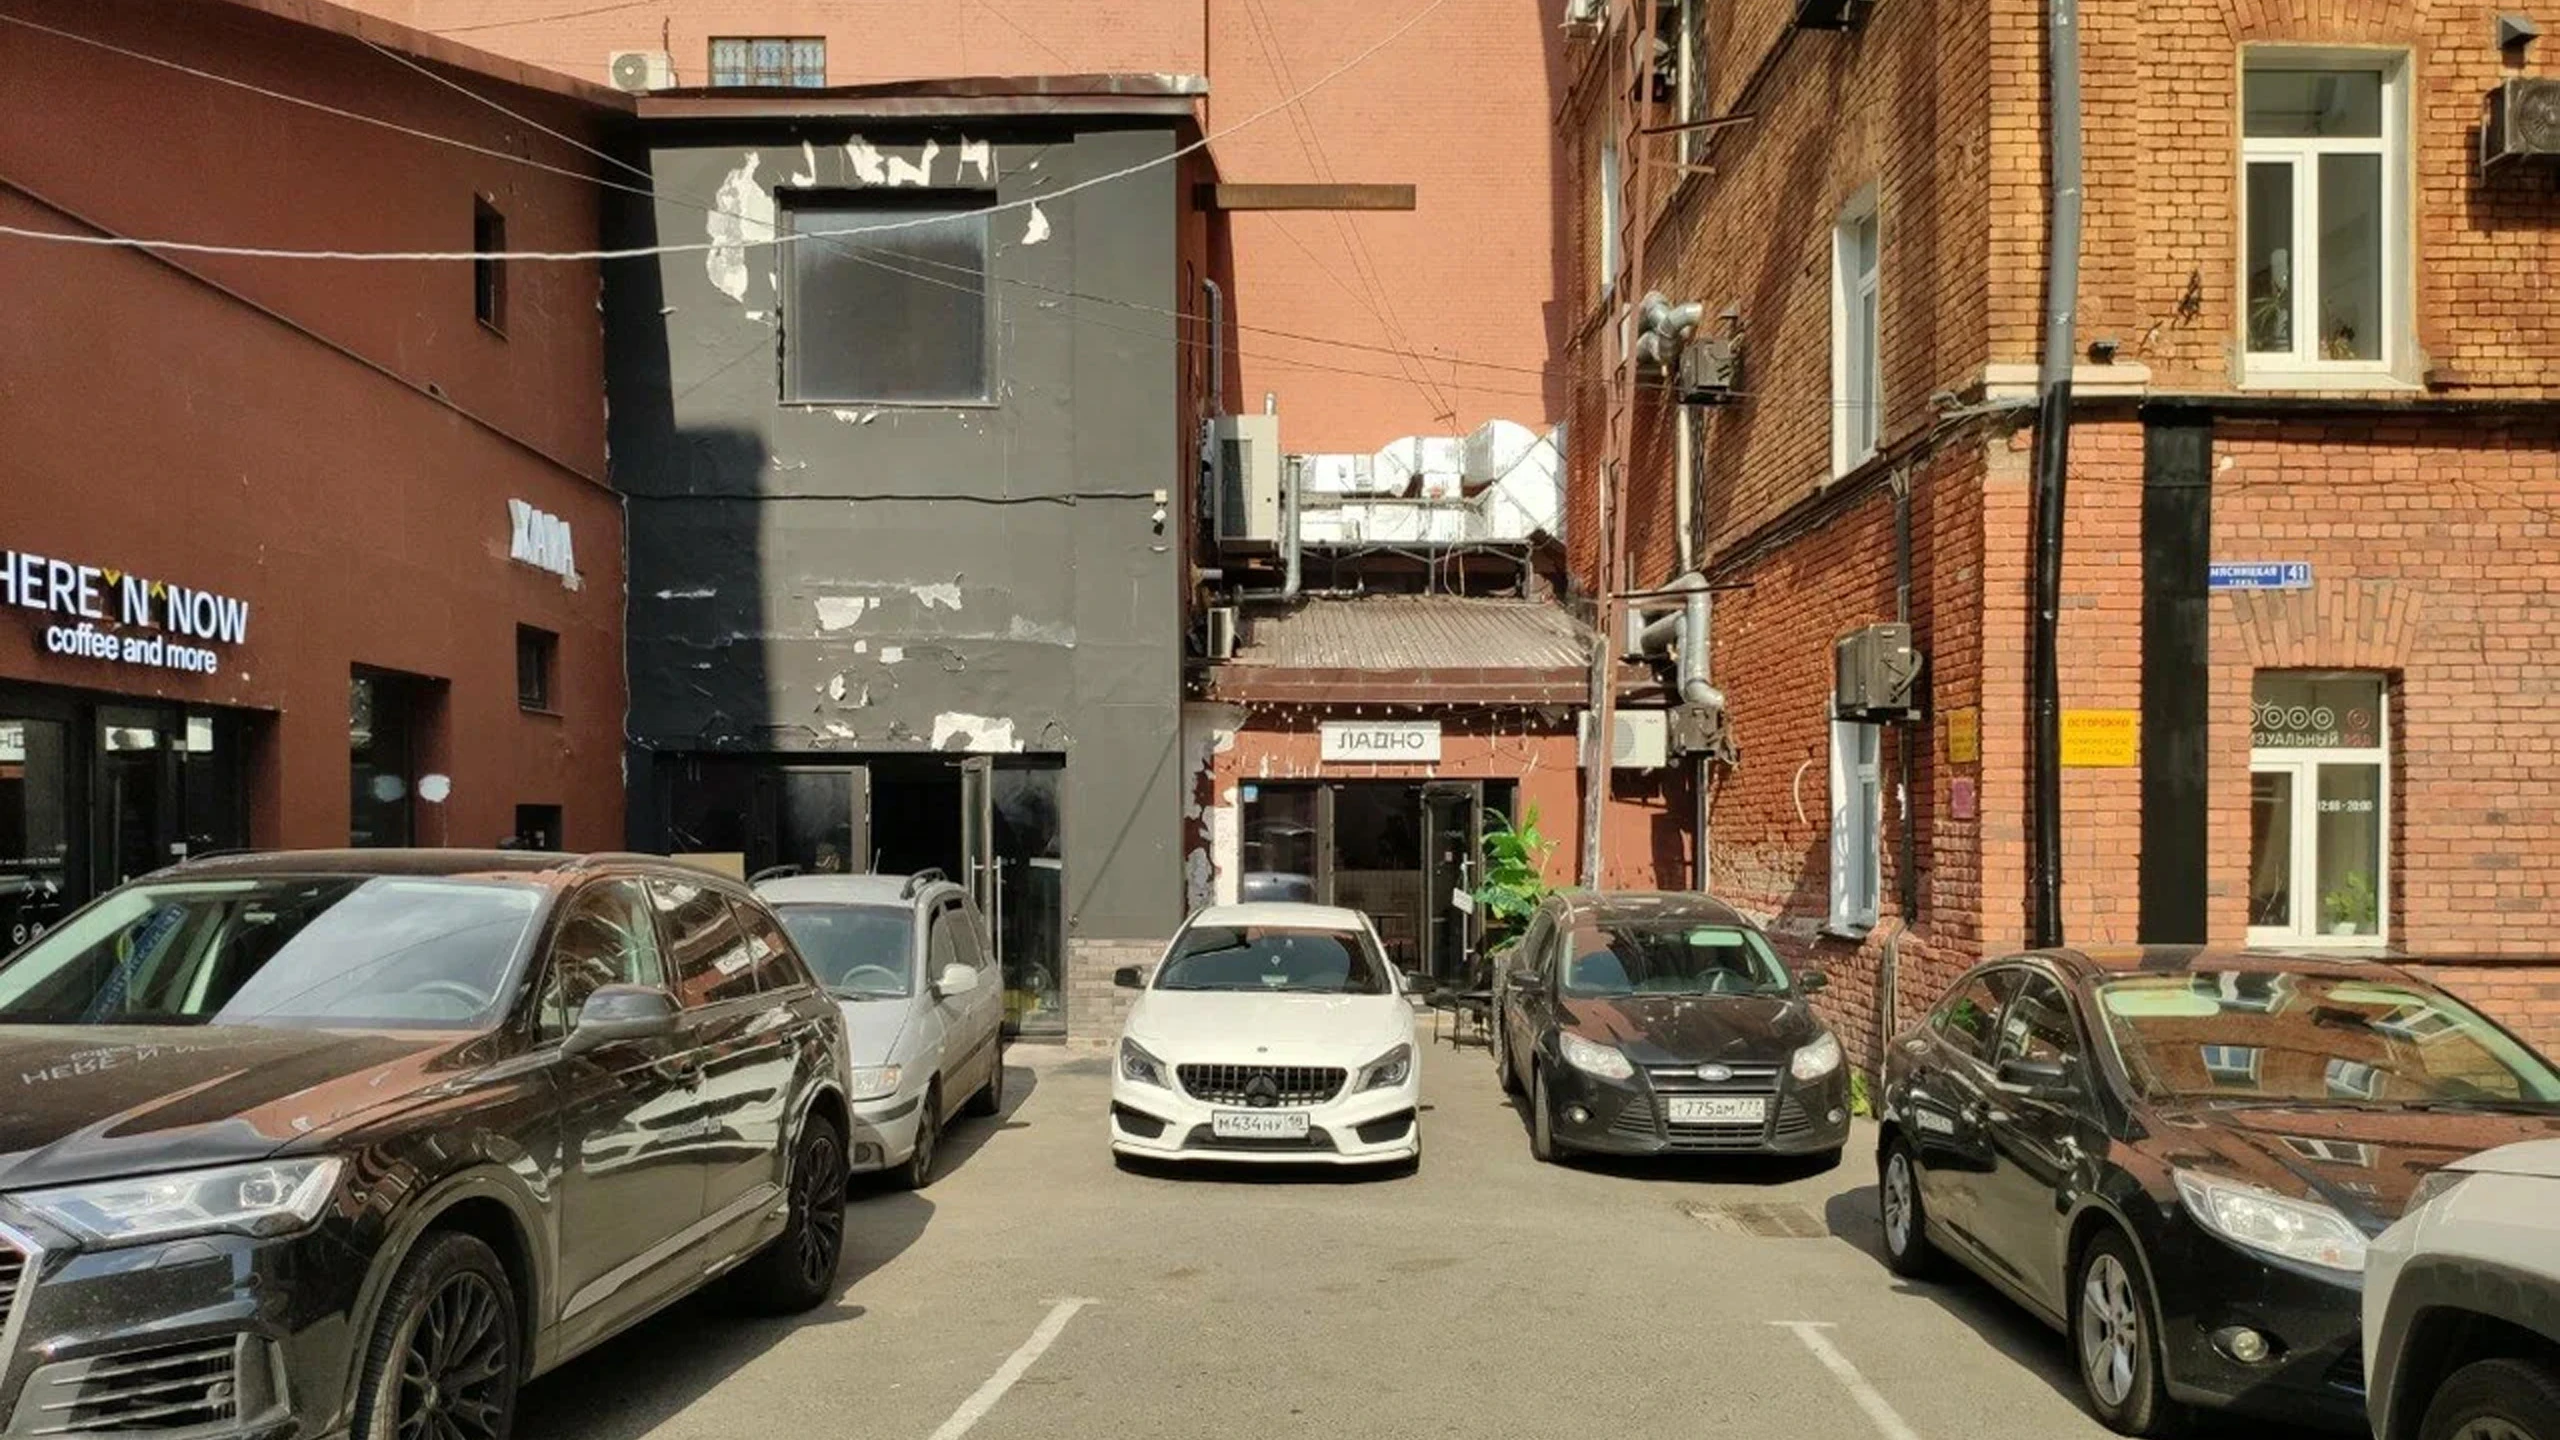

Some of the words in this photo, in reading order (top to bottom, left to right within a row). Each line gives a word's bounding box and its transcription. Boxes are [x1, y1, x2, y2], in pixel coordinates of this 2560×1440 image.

[2287, 565, 2305, 580] 41
[0, 551, 103, 619] HERE
[167, 584, 249, 645] NOW
[47, 622, 120, 661] coffee
[123, 634, 163, 668] and
[166, 643, 218, 675] more
[1337, 731, 1425, 750] ЛАДНО
